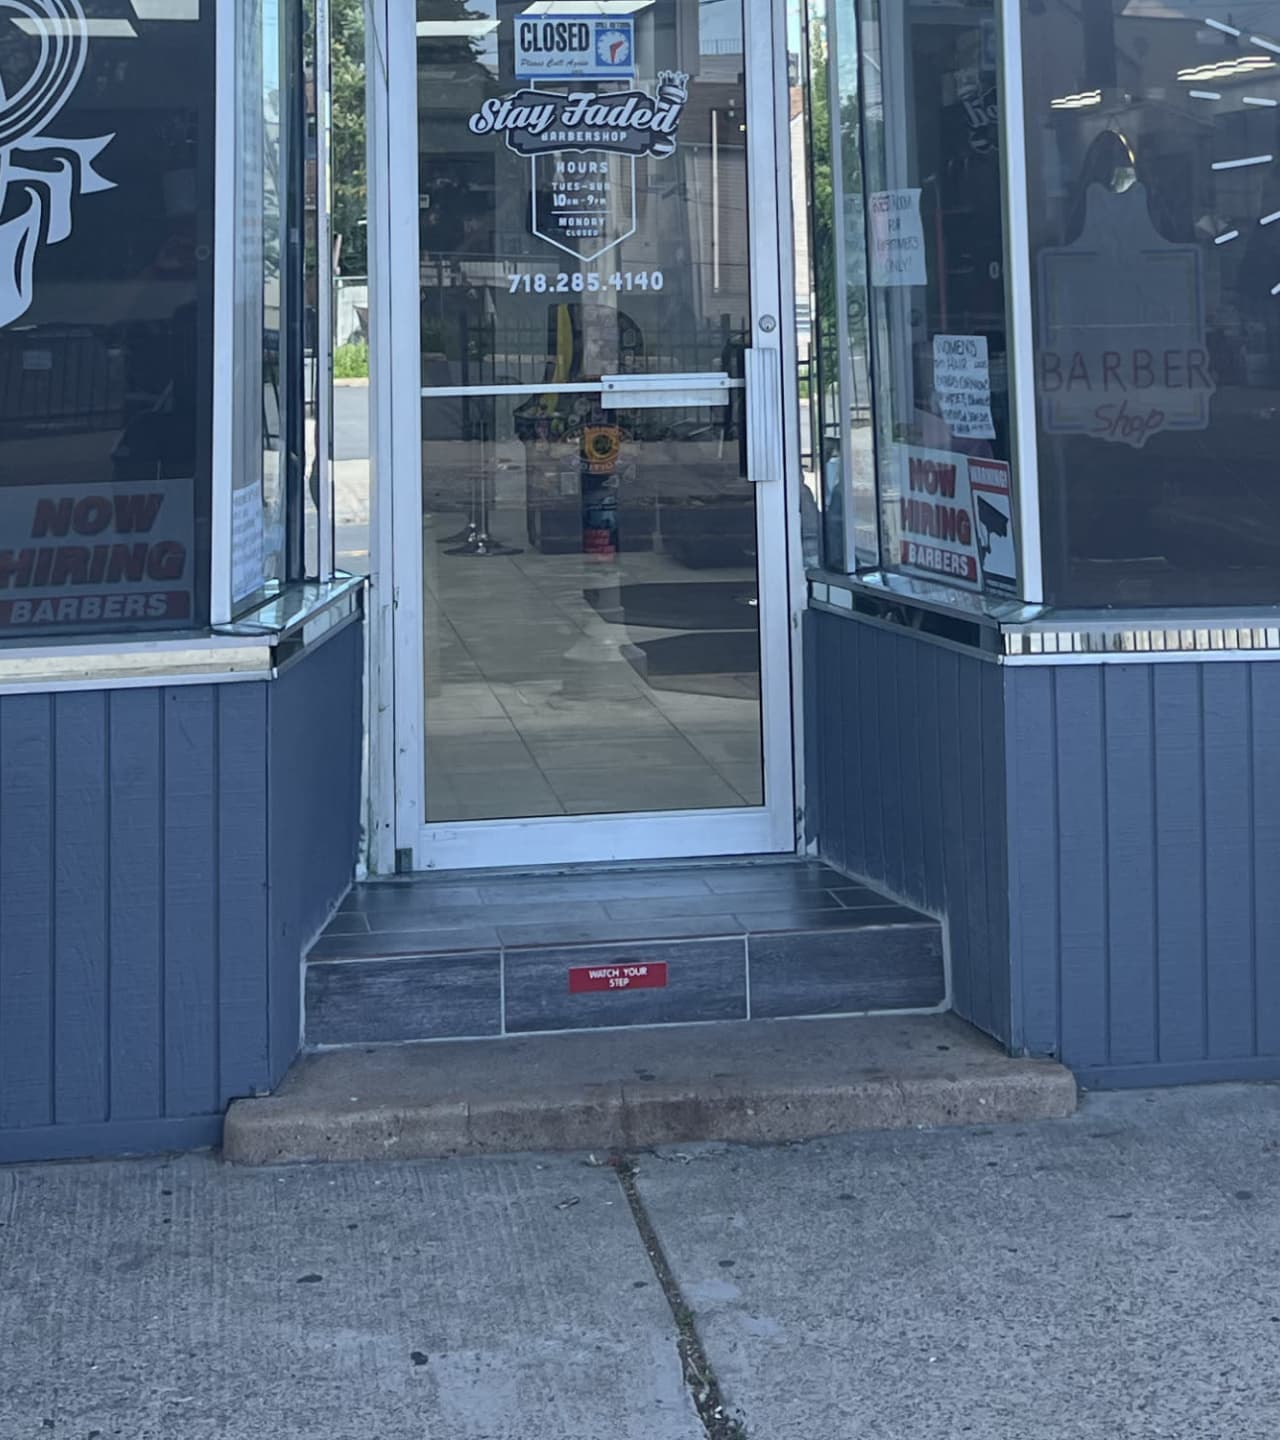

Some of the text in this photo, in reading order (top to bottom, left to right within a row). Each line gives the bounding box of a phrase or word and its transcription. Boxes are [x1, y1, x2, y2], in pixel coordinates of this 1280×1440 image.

[520, 22, 590, 52] CLOSED
[469, 93, 680, 134] Stay Faded
[541, 131, 627, 142] BARBERSHOP
[556, 161, 609, 174] HOURS
[558, 217, 605, 227] MONDAY
[565, 229, 599, 237] CLOSED
[508, 271, 664, 293] 718.285.4140
[1041, 350, 1211, 392] BARBER
[1091, 403, 1165, 441] Shop
[908, 457, 957, 499] NOW
[30, 494, 165, 539] NOW
[900, 496, 972, 546] HIRING
[908, 543, 969, 577] BARBERS
[9, 592, 168, 624] BARBERS
[588, 966, 648, 979] WATCH YOUR
[608, 977, 630, 988] STEP
